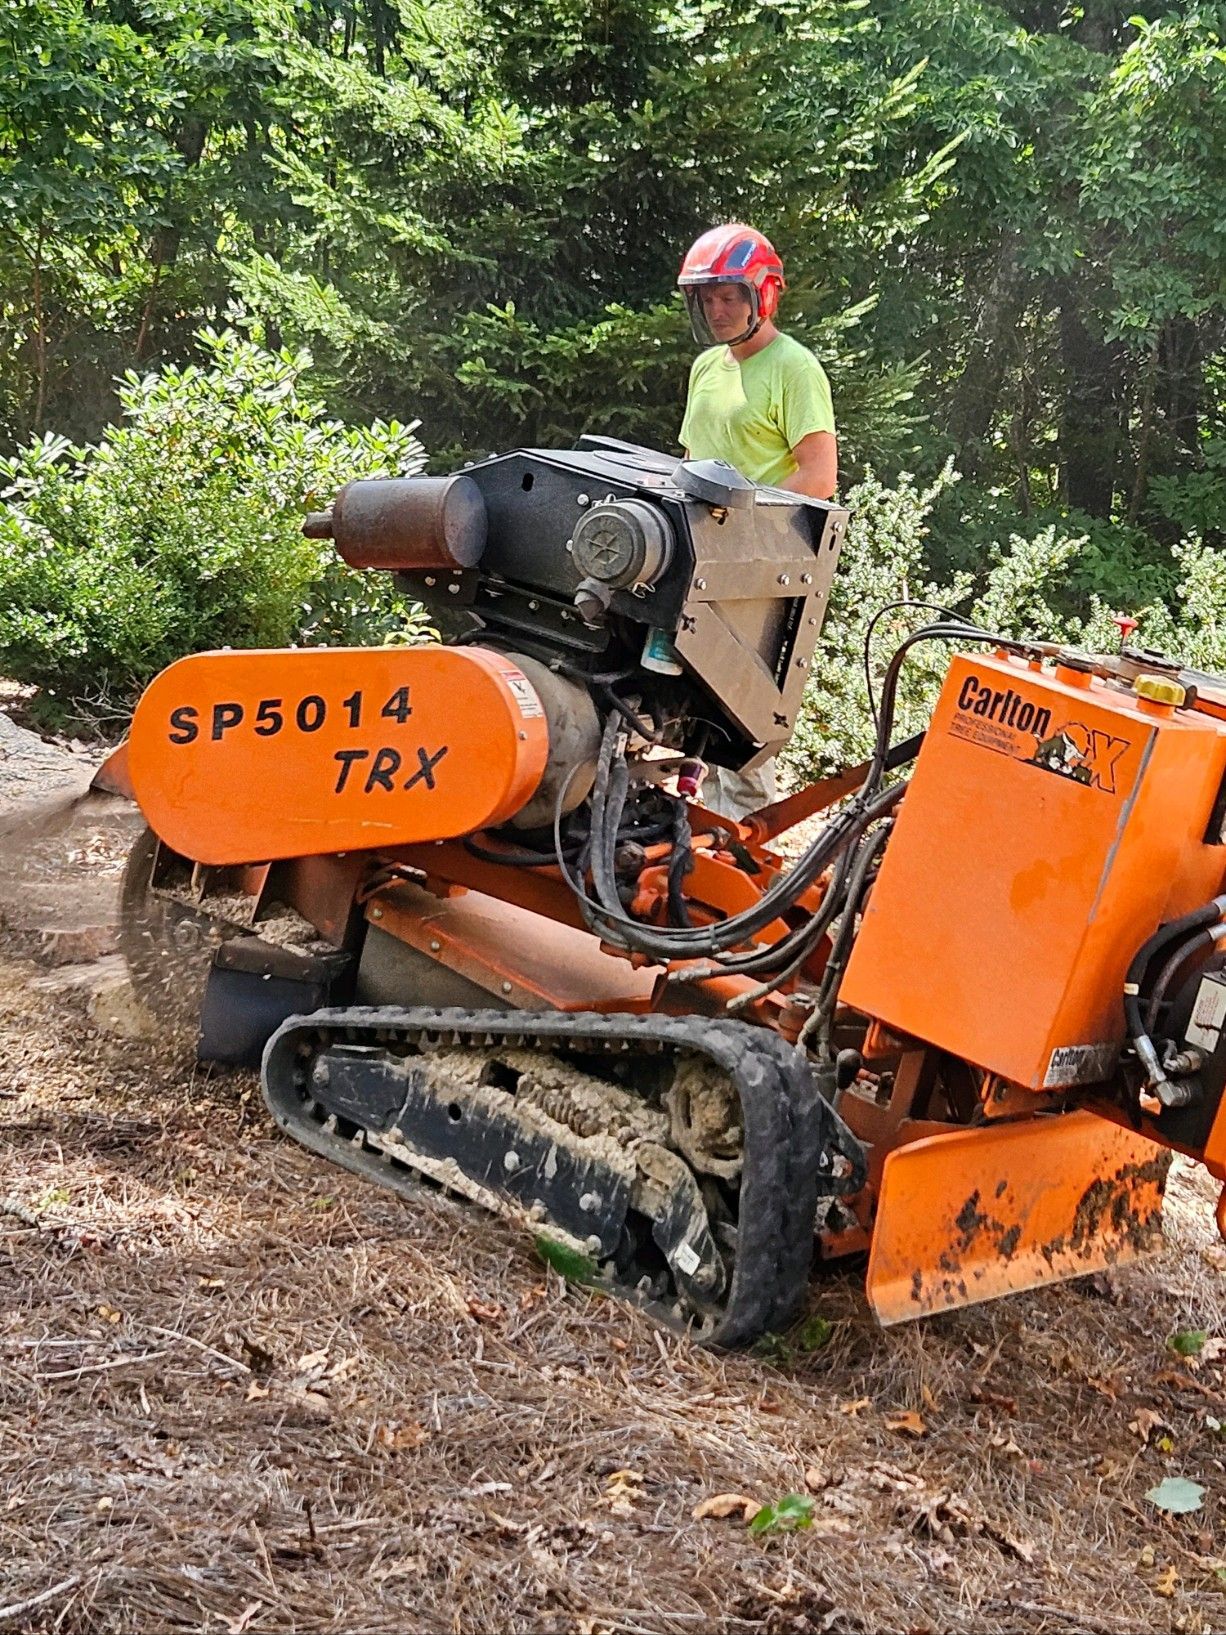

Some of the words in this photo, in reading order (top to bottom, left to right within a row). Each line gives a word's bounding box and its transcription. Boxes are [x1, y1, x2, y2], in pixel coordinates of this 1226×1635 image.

[168, 686, 413, 745] SP5014
[957, 675, 1052, 739] Carlton
[333, 746, 449, 795] TRX
